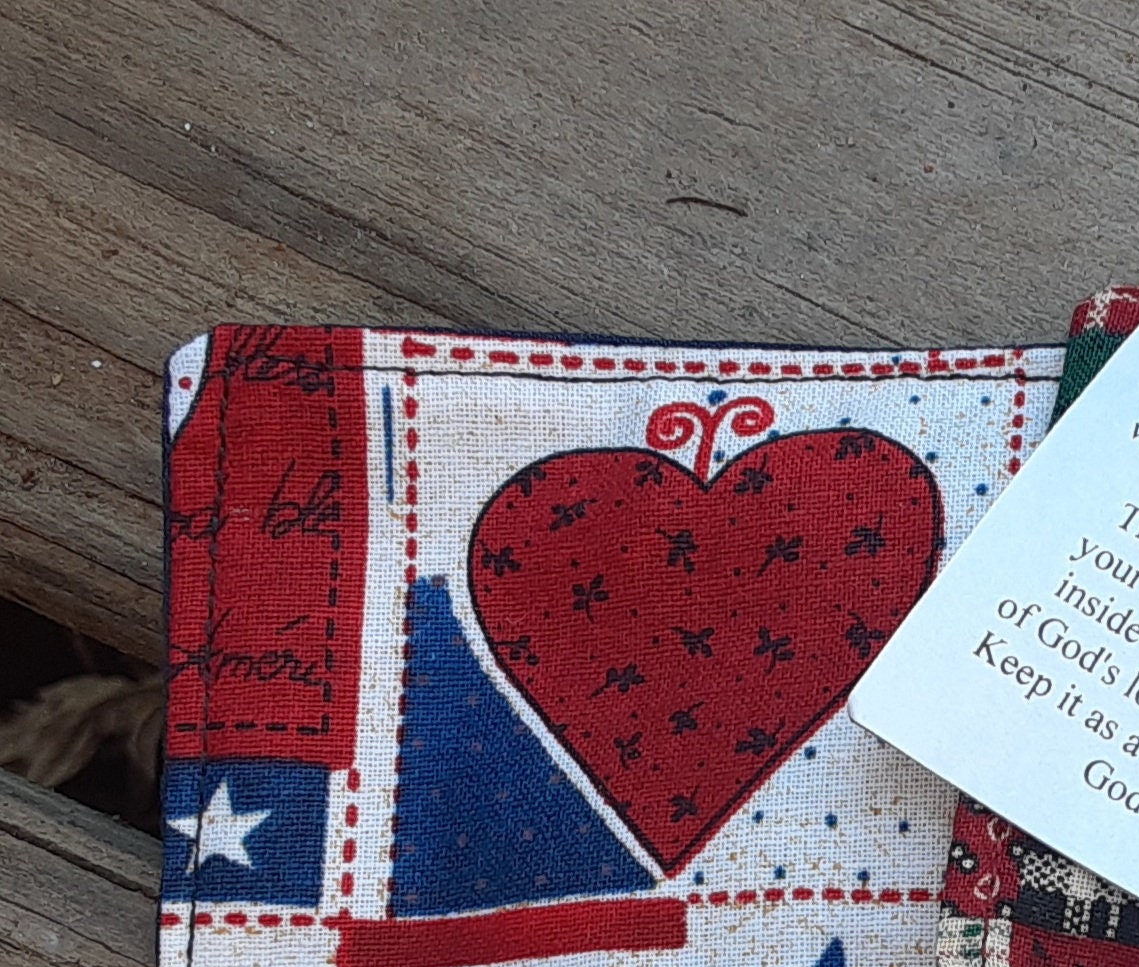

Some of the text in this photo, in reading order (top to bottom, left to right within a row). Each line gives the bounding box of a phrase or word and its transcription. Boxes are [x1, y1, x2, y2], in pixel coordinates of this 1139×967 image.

[972, 630, 1053, 701] Keep
[1056, 683, 1084, 717] it
[1084, 709, 1119, 740] as
[997, 599, 1042, 629] of
[1037, 617, 1121, 686] God's
